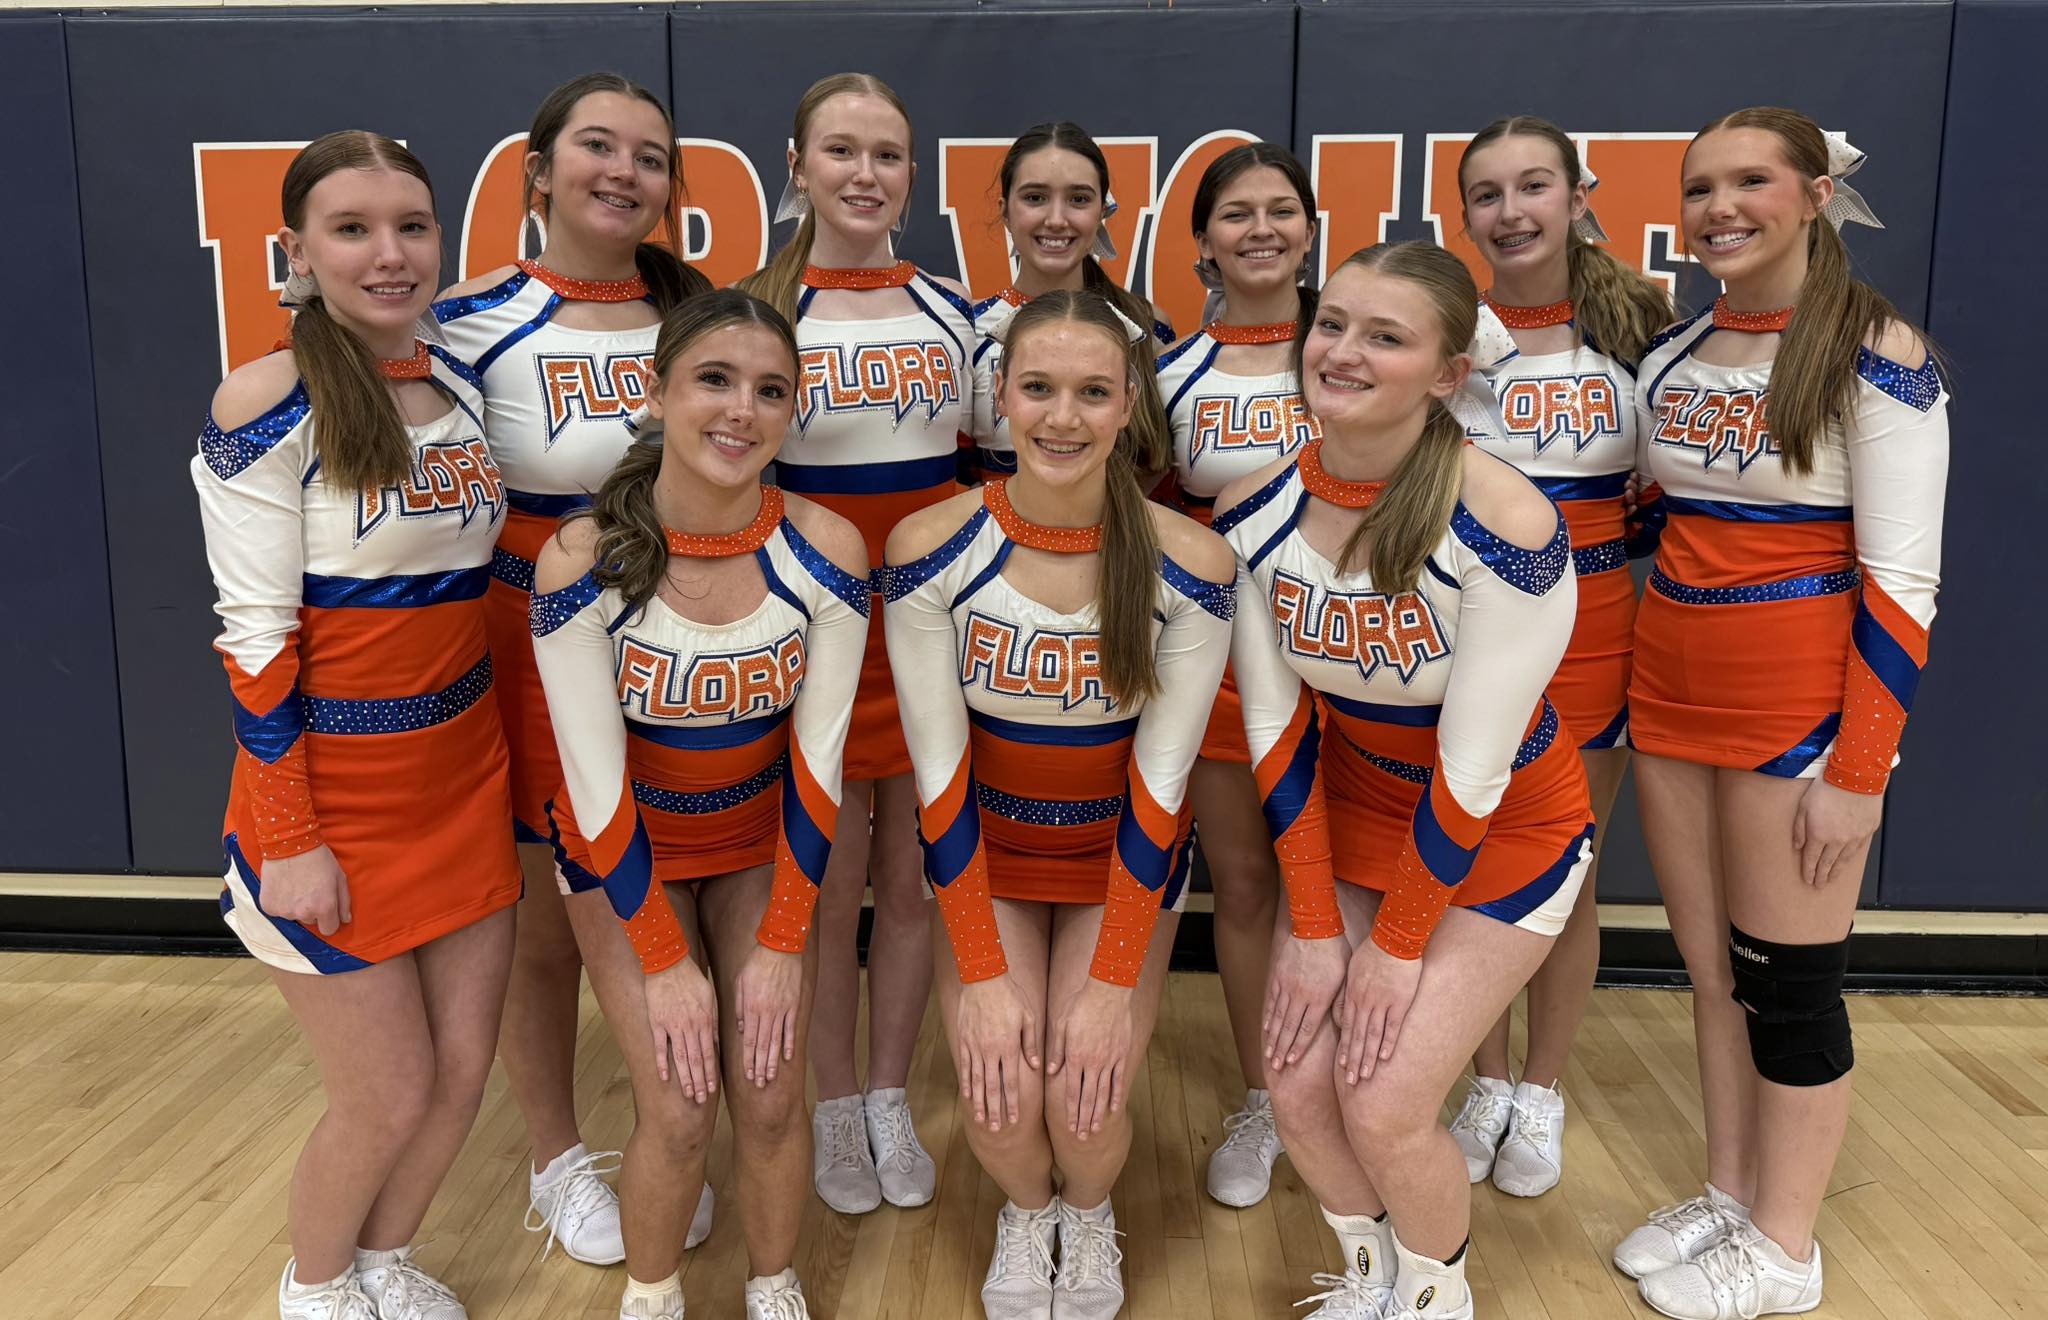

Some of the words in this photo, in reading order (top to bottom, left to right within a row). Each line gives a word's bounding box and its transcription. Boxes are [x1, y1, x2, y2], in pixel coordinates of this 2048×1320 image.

[537, 352, 655, 443] FLO
[796, 341, 959, 433] FLORA
[1189, 392, 1323, 468] FLOR
[1466, 373, 1621, 453] ORA
[961, 610, 1119, 713] FLOR
[1270, 569, 1452, 686] FLORA
[616, 628, 806, 722] FLORA
[1417, 1286, 1433, 1308] ULTRA
